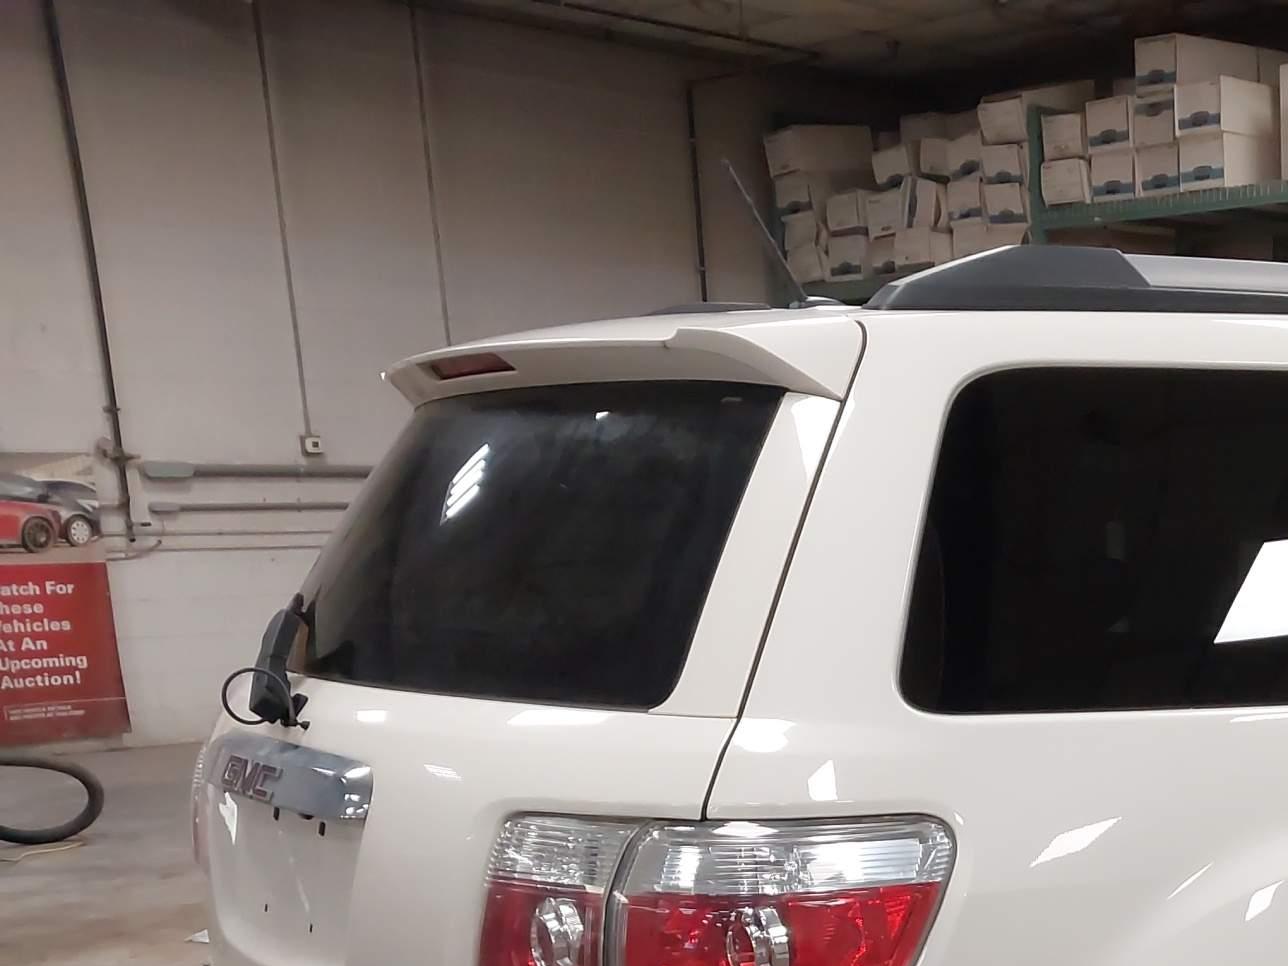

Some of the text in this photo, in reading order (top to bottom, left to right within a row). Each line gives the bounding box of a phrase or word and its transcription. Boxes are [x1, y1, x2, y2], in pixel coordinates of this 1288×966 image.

[0, 581, 75, 596] atch For
[0, 602, 44, 615] hese
[0, 618, 71, 633] ehicles
[21, 637, 48, 651] An
[0, 653, 88, 673] Upcoming
[1, 670, 81, 689] Auction!
[221, 754, 282, 804] GMC
